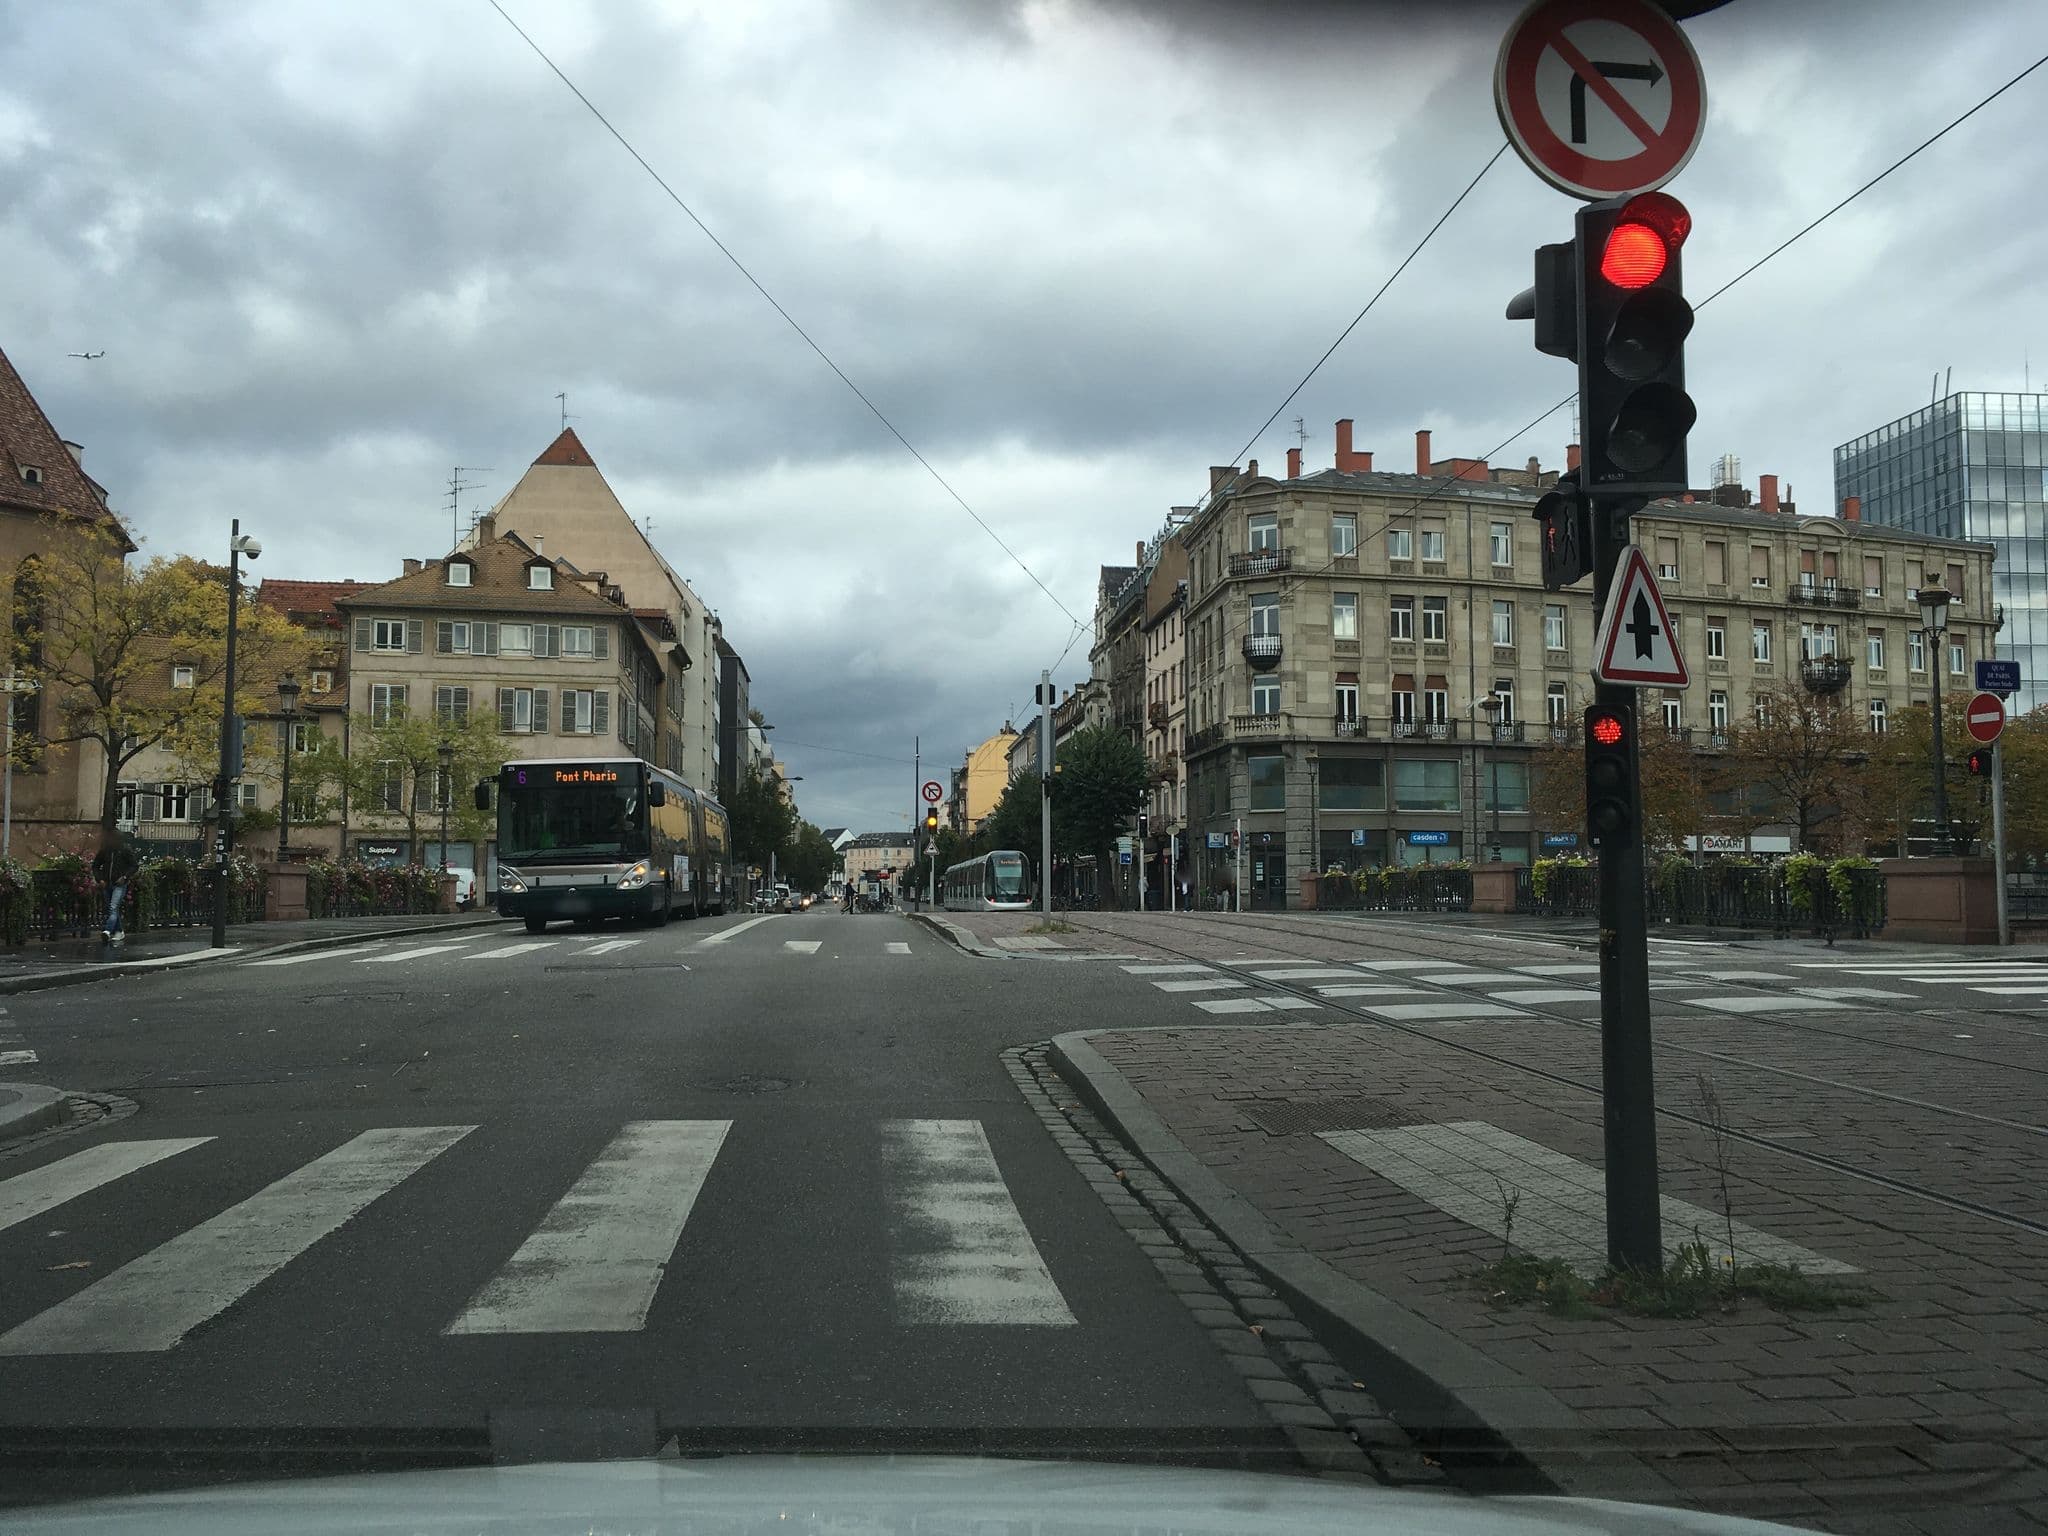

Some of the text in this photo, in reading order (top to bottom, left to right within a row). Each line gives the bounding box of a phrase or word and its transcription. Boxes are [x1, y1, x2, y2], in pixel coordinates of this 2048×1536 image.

[518, 769, 618, 784] 6 Pont Phario
[1412, 833, 1438, 841] casden
[1704, 837, 1743, 849] DAMART
[368, 846, 398, 855] Supplay
